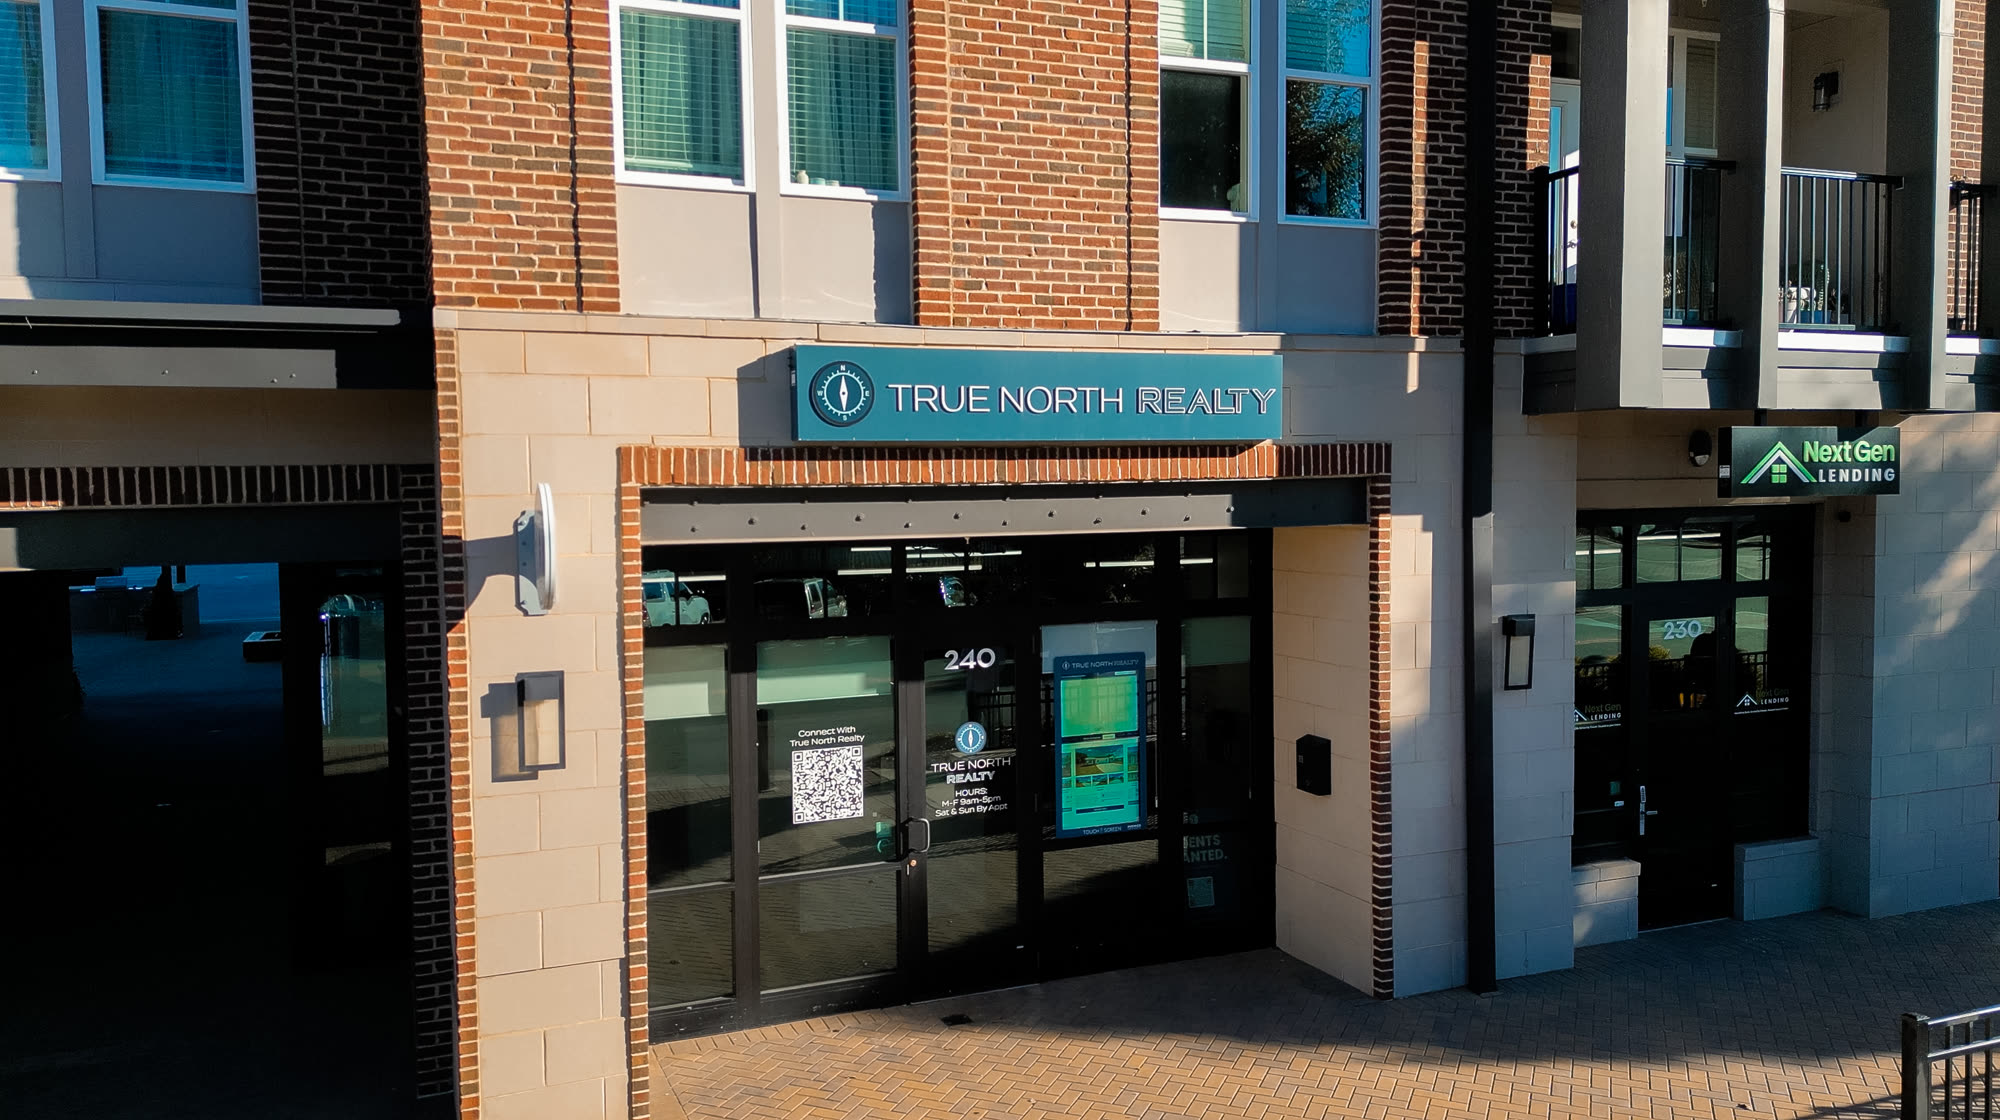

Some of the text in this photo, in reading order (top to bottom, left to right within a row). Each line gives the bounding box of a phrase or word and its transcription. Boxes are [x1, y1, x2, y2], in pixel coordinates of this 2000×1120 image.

[887, 383, 1277, 415] TRUE NORTH REALTY
[1803, 440, 1896, 463] Next Gen
[1818, 468, 1896, 483] LENDING
[1663, 619, 1702, 640] 230
[944, 647, 996, 671] 240
[1090, 660, 1114, 668] NORTH
[1760, 696, 1790, 705] LENDING
[1584, 703, 1622, 714] Next Gen
[1590, 712, 1622, 721] LENDING
[798, 726, 856, 737] Connect With
[789, 735, 865, 747] True North Realty
[931, 757, 1011, 774] TRUE NORTH
[946, 770, 996, 785] REALTY
[955, 787, 988, 798] HOURS:
[941, 794, 1001, 808] M-F 9am-5pm
[935, 802, 1008, 817] Sat & Sun By Appt
